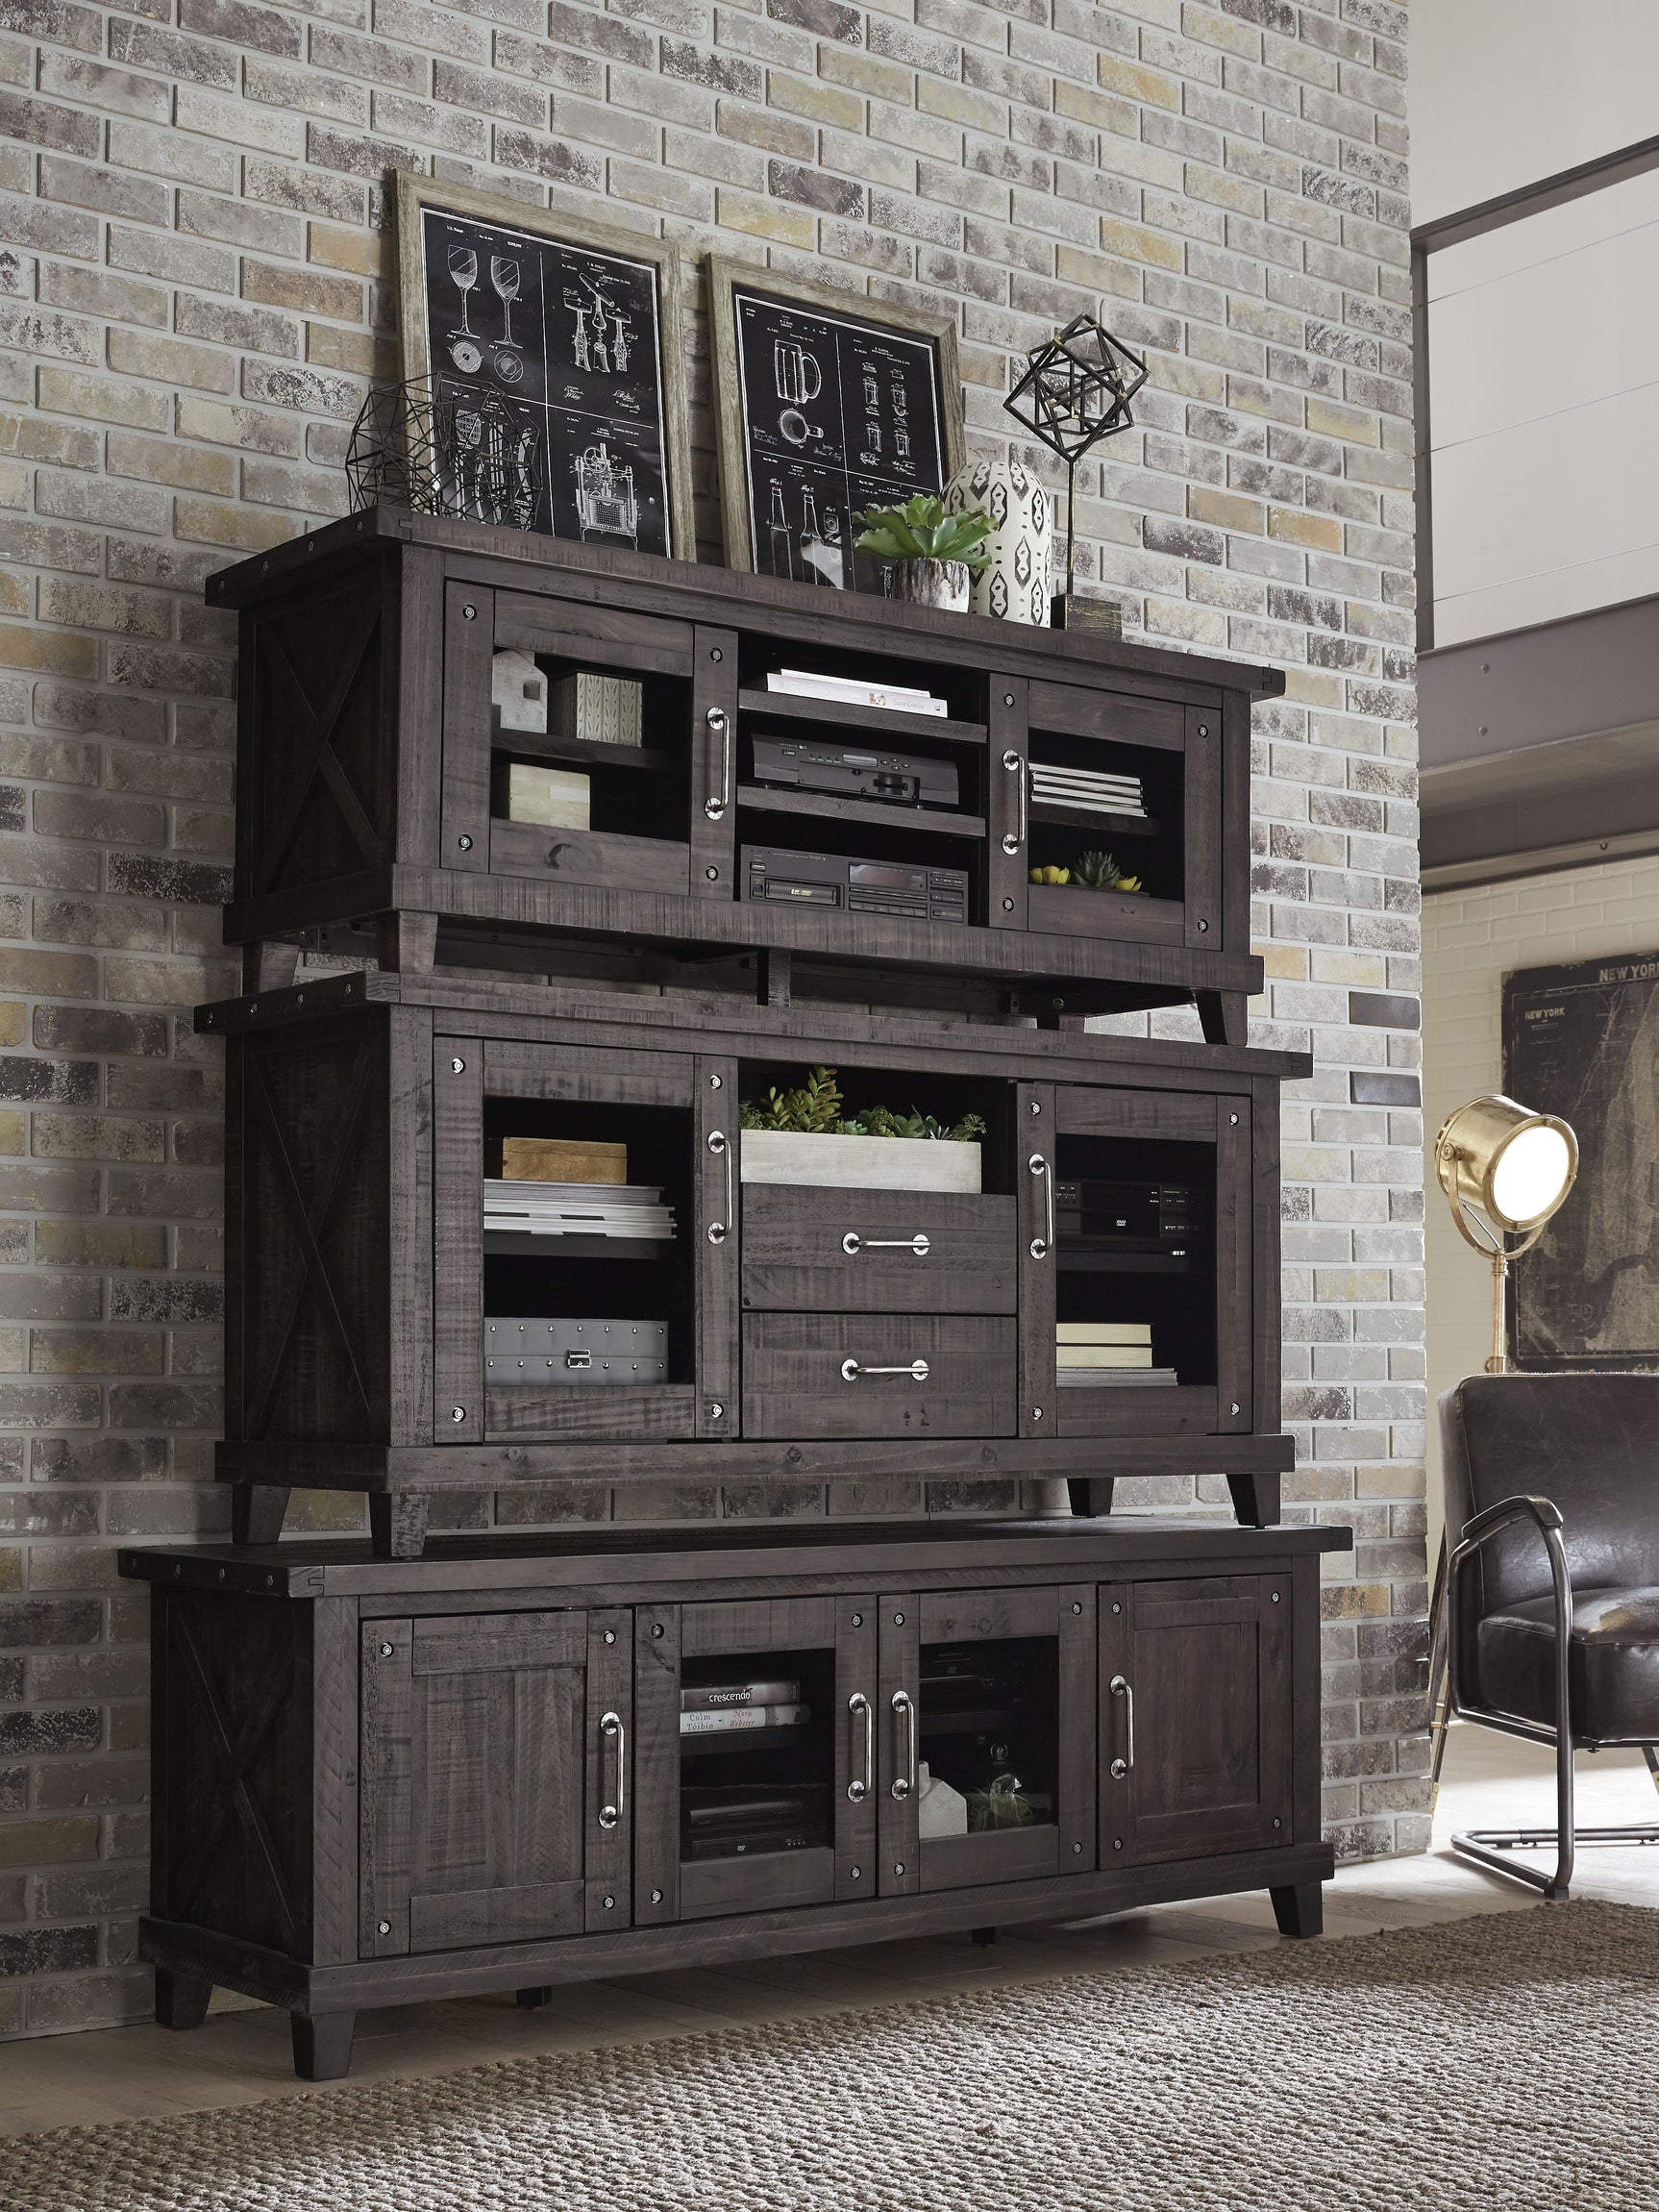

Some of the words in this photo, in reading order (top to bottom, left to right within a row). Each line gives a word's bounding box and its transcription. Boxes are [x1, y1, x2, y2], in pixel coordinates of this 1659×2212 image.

[1599, 966, 1628, 982] NEW
[1630, 962, 1659, 979] YOR
[1524, 1009, 1543, 1020] NEW
[1543, 1007, 1565, 1018] YORK
[708, 1689, 751, 1702] crescendo
[689, 1712, 711, 1722] Colm
[733, 1709, 752, 1718] Nora
[730, 1719, 755, 1727] Webster
